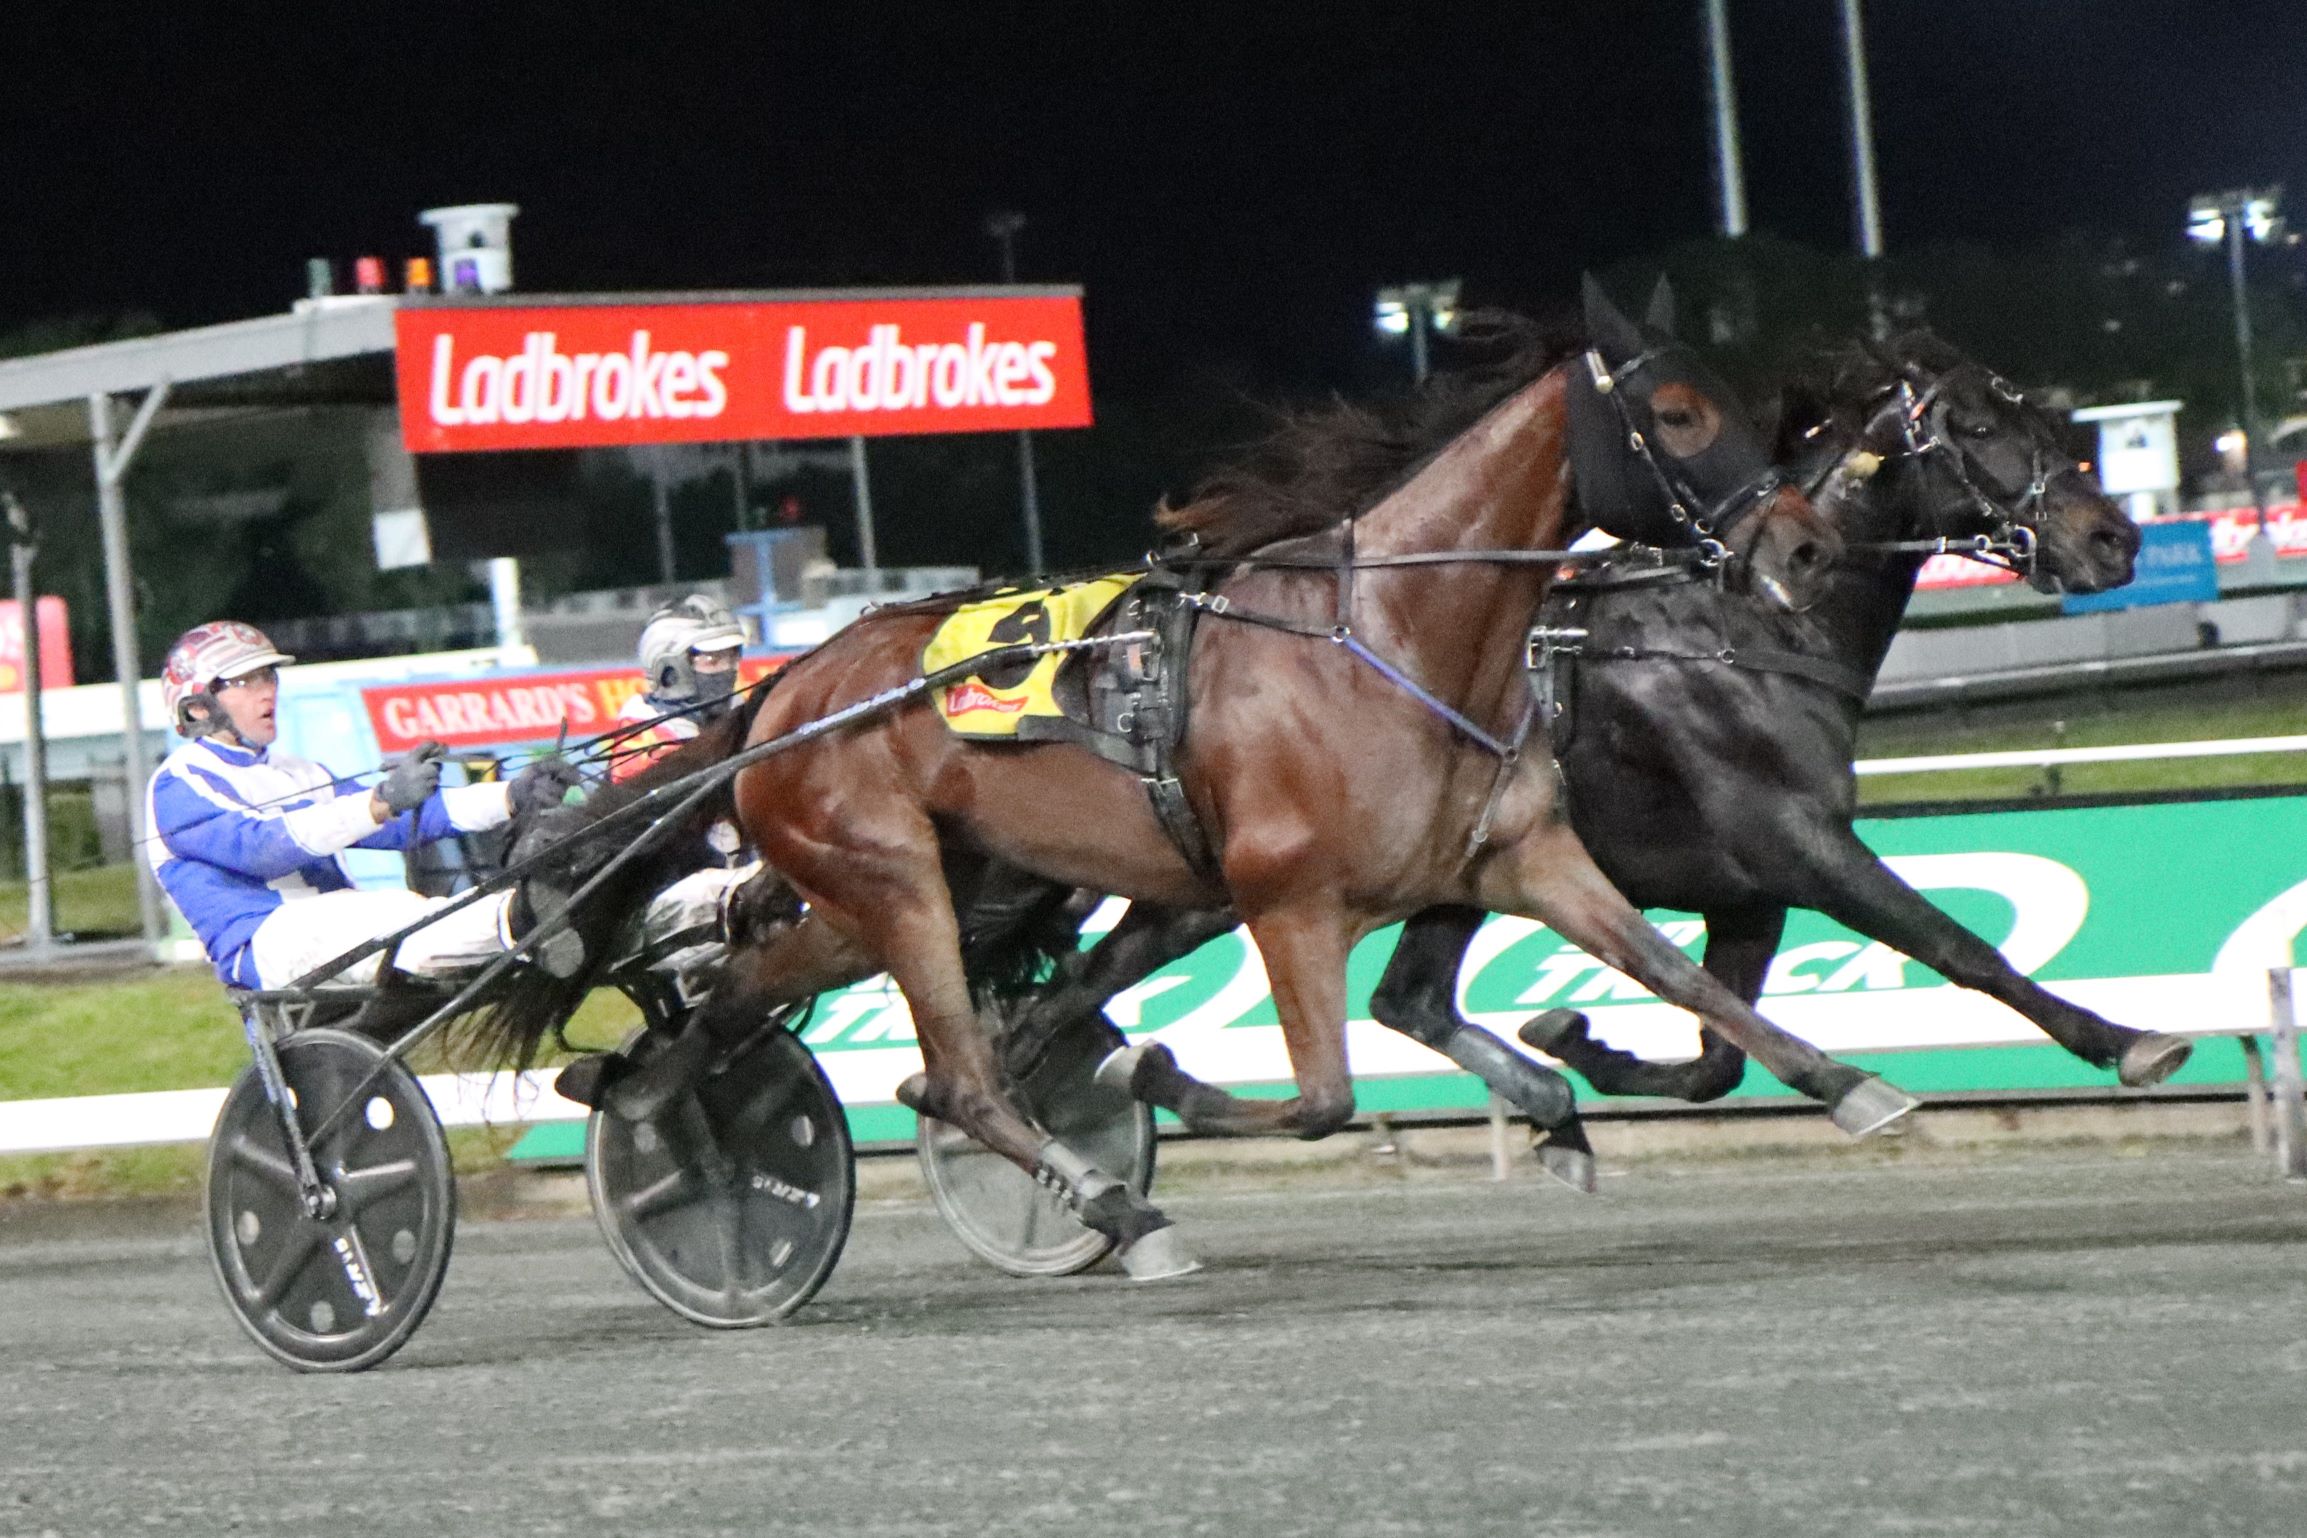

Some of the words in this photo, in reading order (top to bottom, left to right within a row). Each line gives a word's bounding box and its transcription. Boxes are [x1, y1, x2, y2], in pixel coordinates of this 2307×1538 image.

[430, 329, 728, 426] Ladbrokes
[783, 322, 1056, 414] Ladbrokes
[383, 682, 597, 740] GARRARD'S
[1514, 941, 1905, 1005] TRCK
